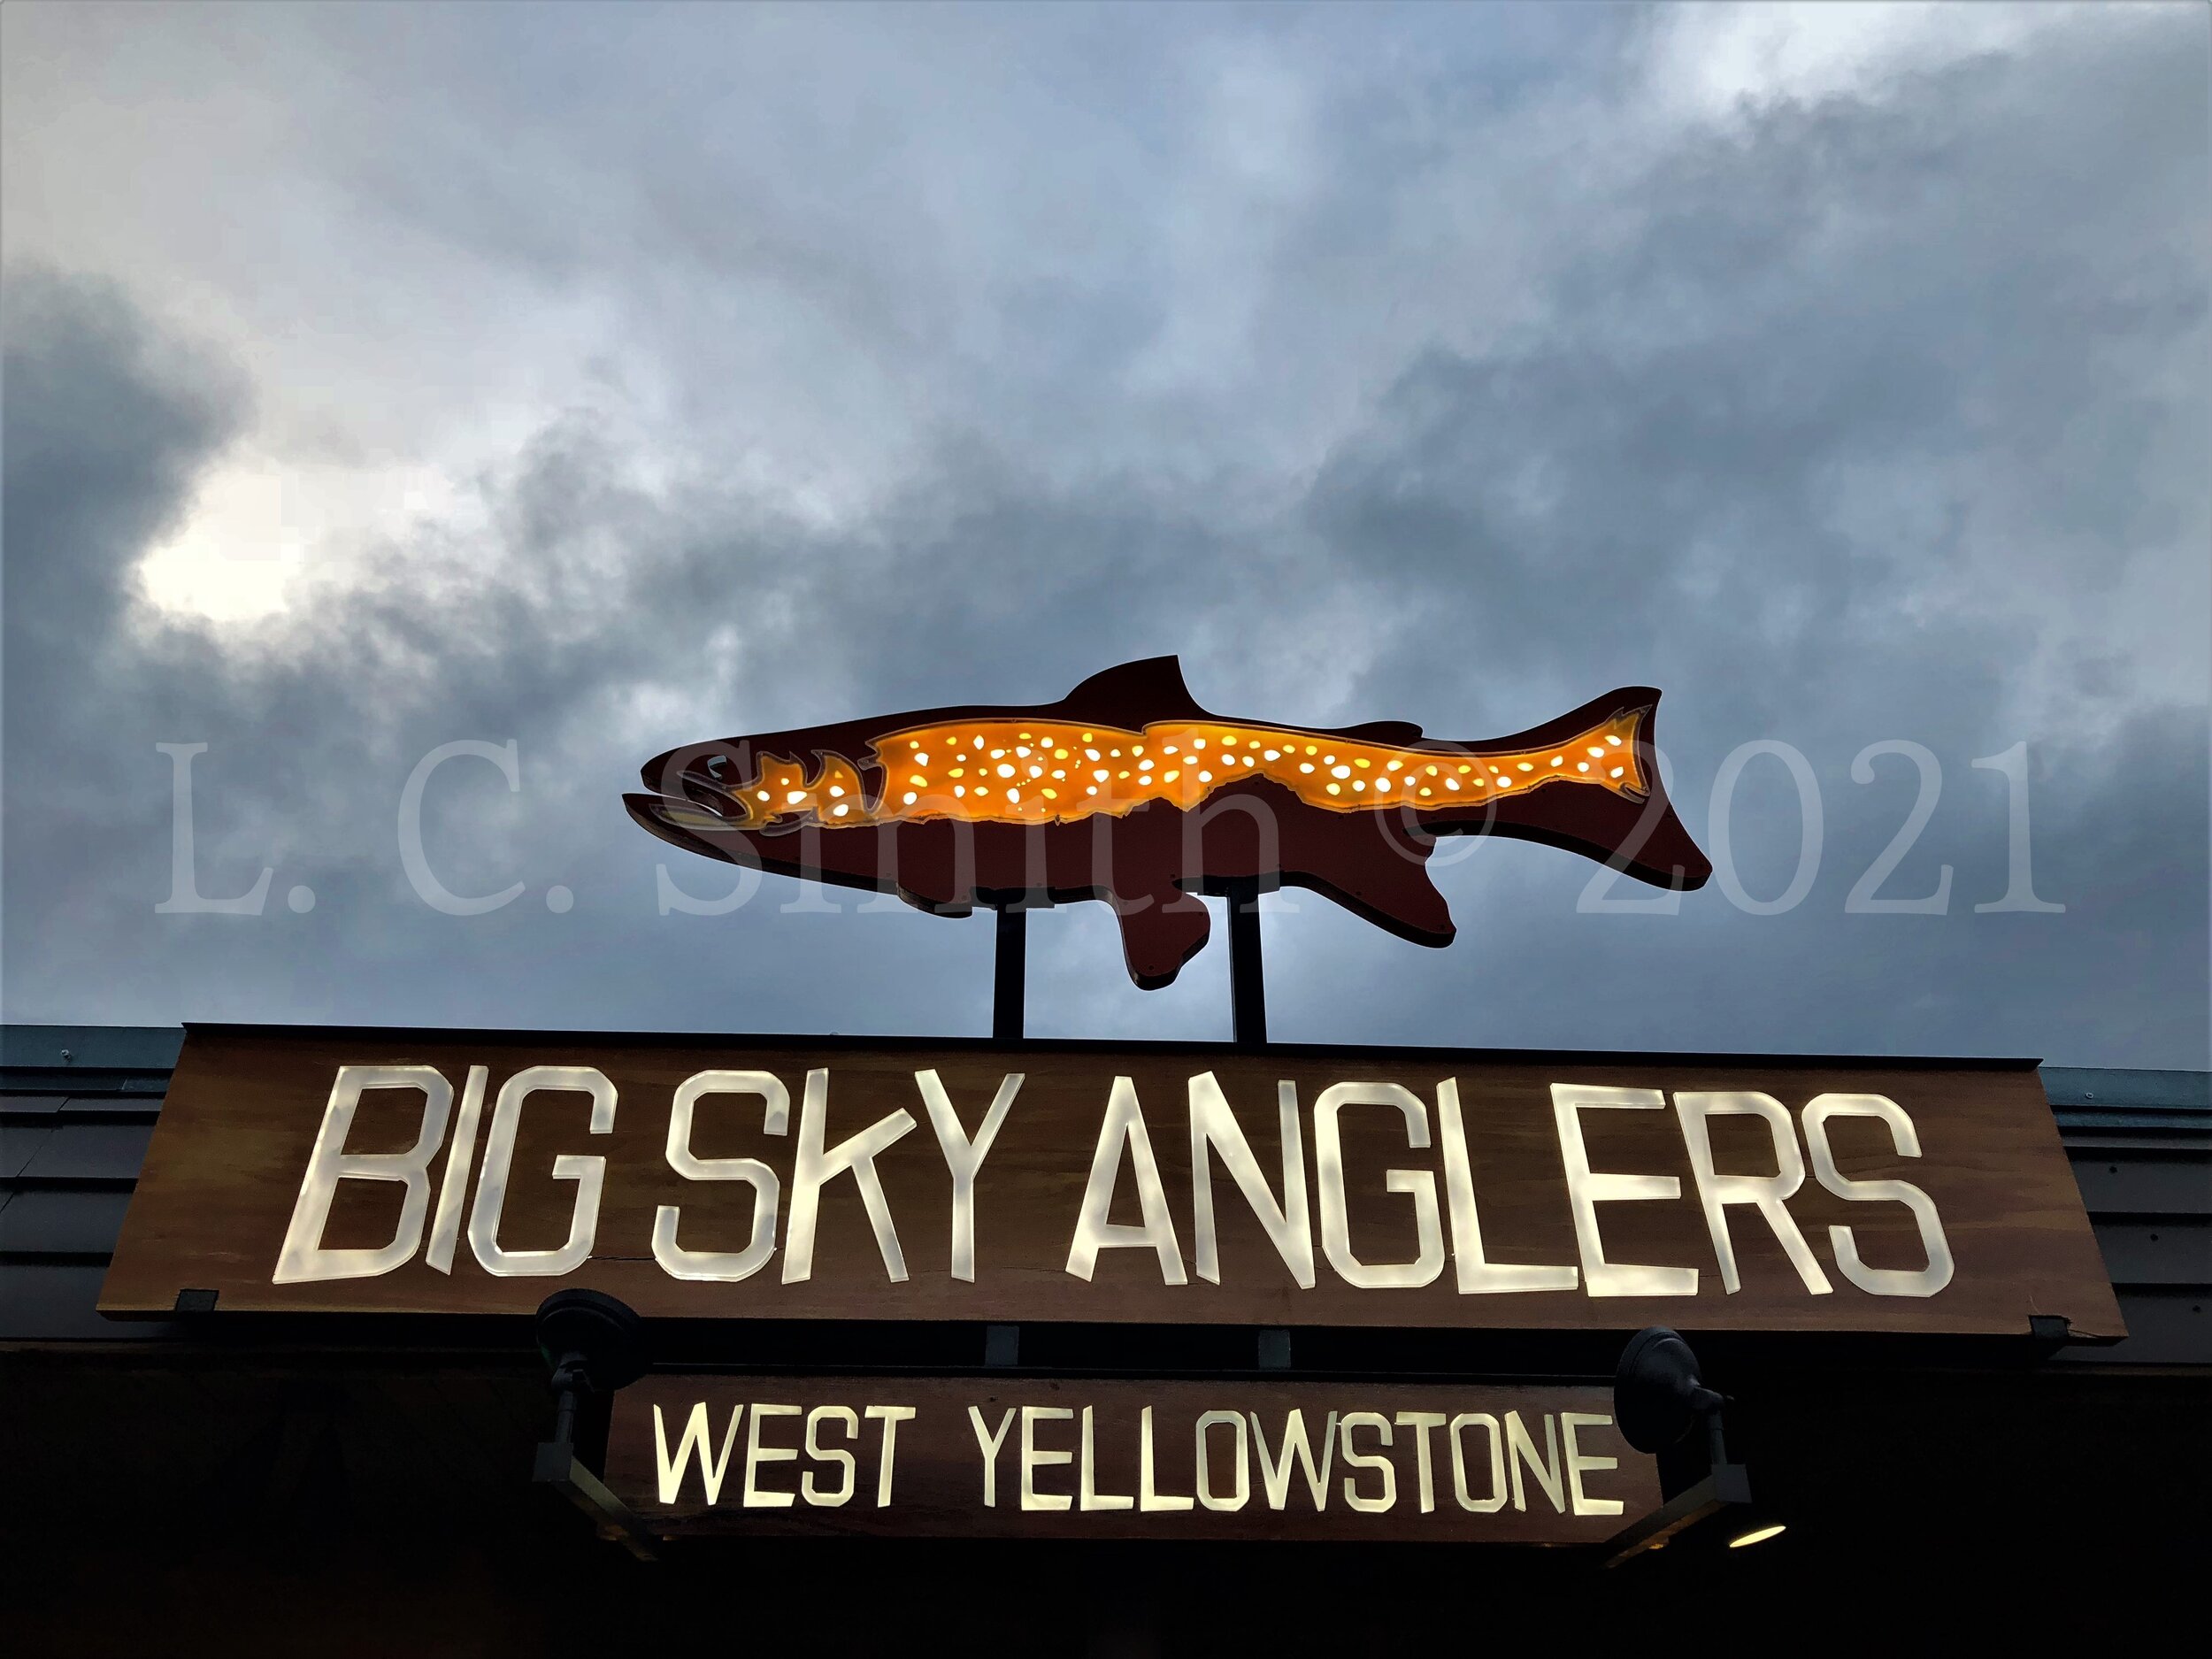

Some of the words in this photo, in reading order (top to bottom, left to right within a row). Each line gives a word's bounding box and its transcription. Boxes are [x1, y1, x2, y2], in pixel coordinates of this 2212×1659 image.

[272, 1064, 618, 1285] BIG
[651, 1068, 1025, 1285] SKY
[1064, 1071, 1955, 1297] ANGLERS
[653, 1402, 917, 1509] WEST
[968, 1404, 1624, 1516] YELLOWSTONE
